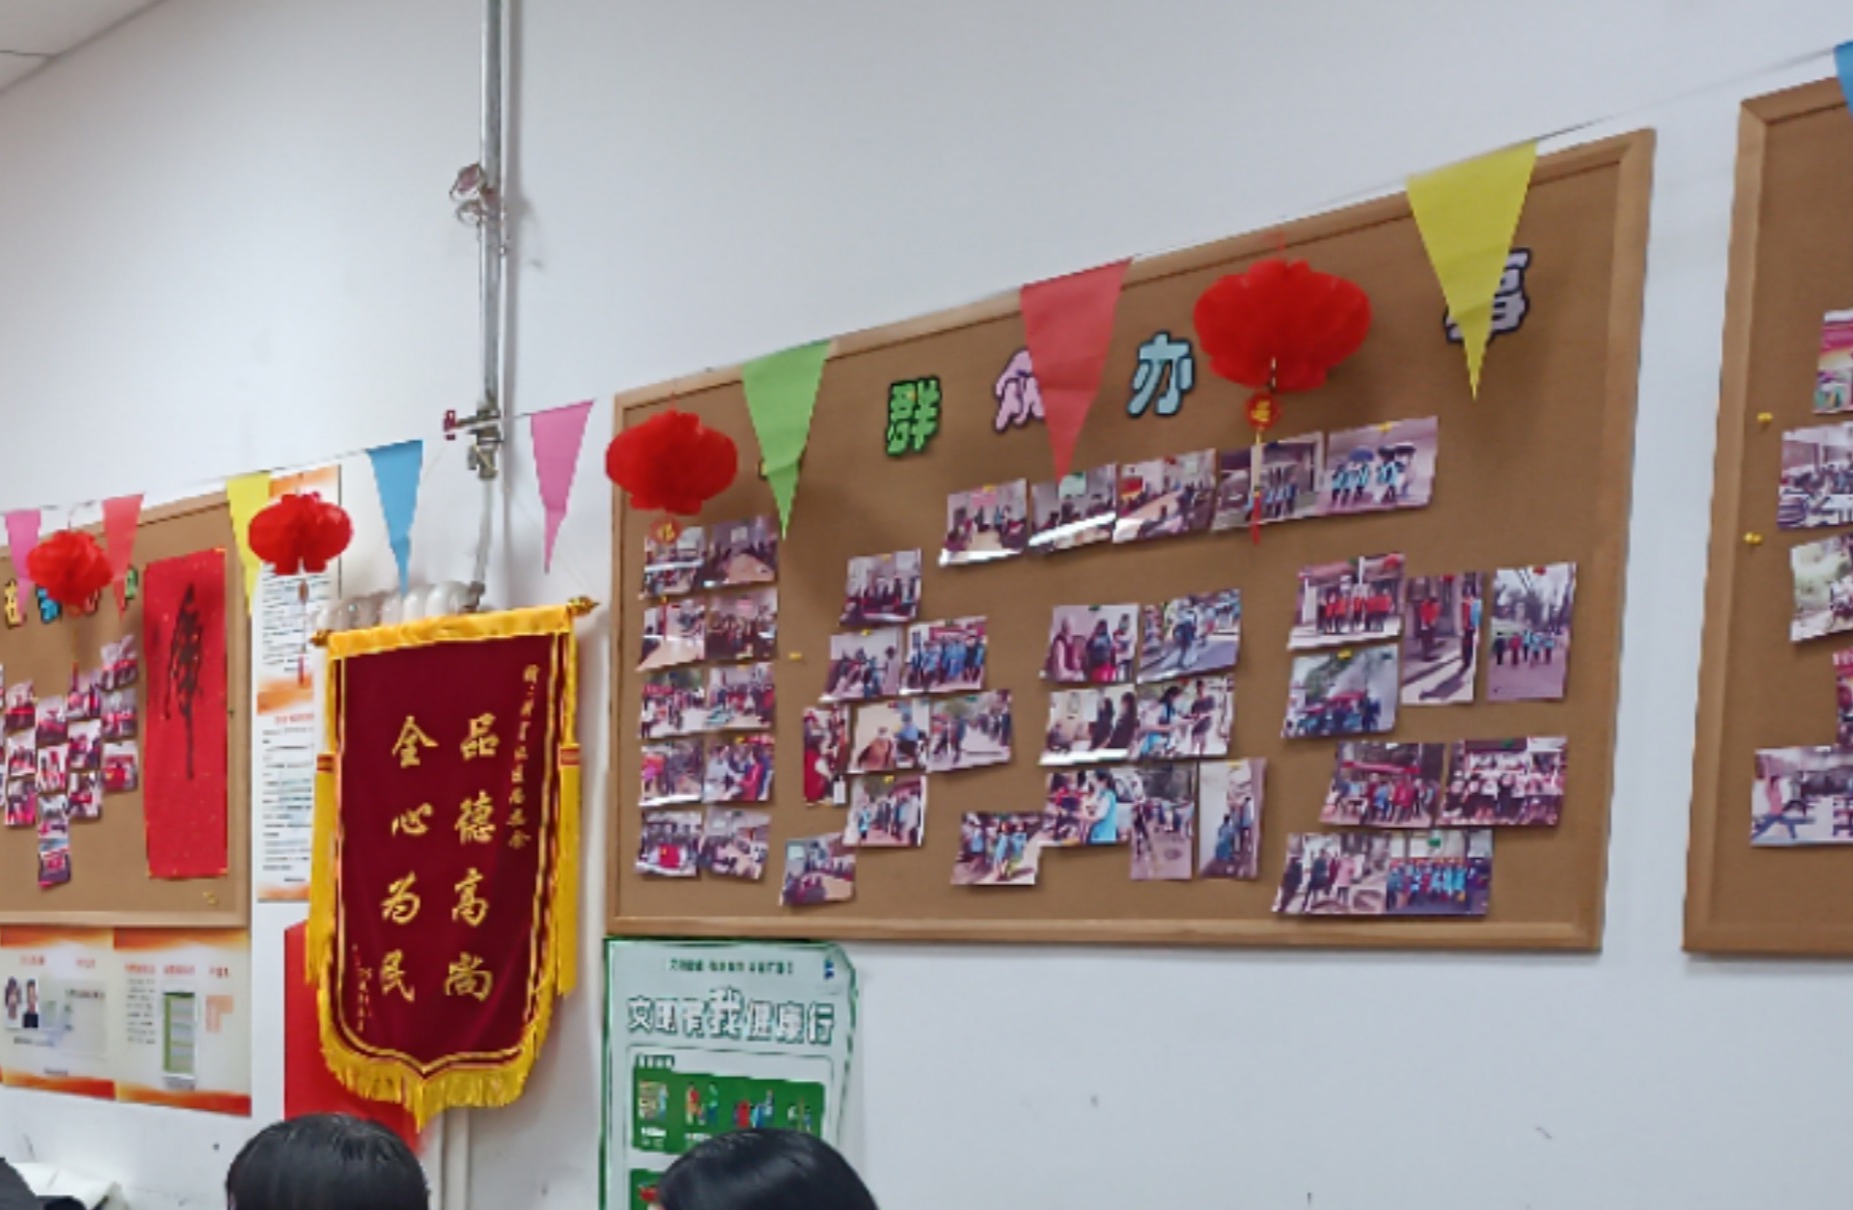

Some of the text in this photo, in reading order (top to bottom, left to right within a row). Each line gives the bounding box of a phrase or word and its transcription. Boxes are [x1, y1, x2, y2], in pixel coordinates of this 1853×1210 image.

[379, 714, 439, 1002] 全心为民
[444, 712, 500, 1002] 品德高尚
[627, 985, 835, 1046] 文明有我健康行
